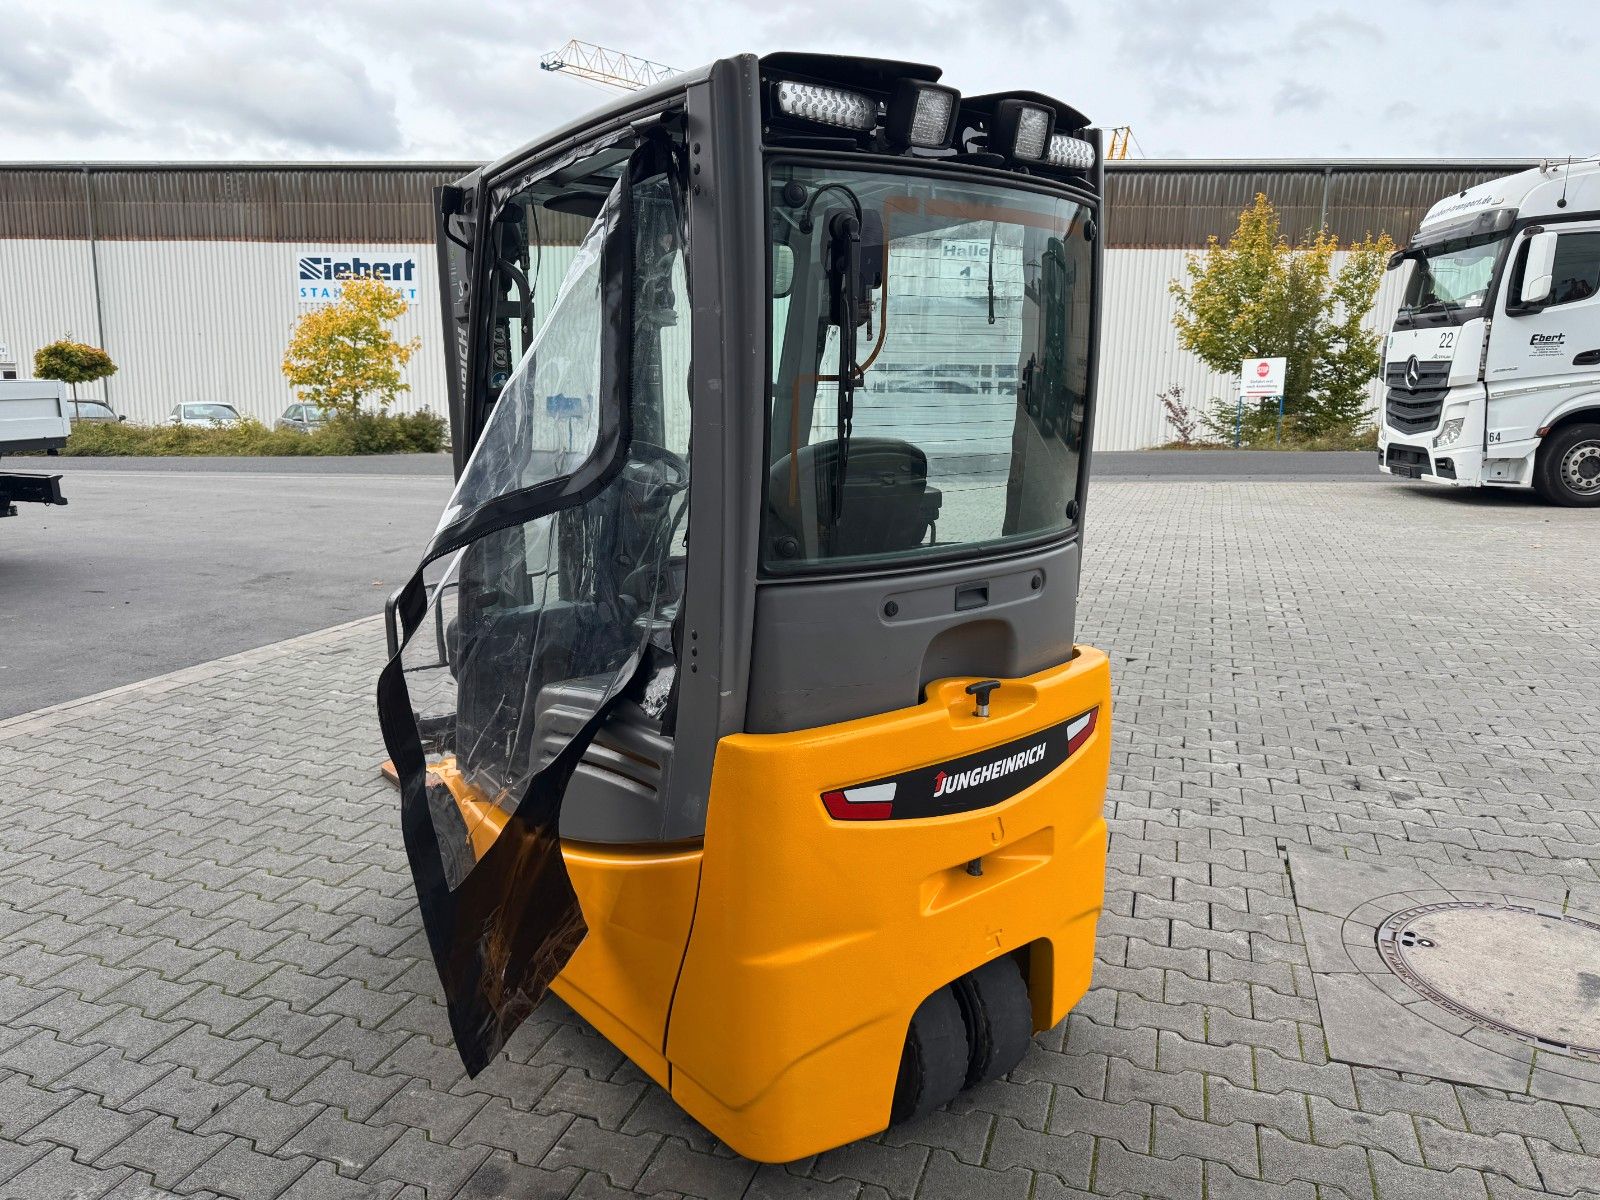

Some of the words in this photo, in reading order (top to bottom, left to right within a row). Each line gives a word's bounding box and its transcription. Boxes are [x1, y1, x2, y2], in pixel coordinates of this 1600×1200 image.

[943, 244, 989, 257] Halle
[299, 257, 416, 281] Siebert
[960, 266, 971, 287] 1
[1439, 332, 1454, 348] 22
[1530, 332, 1566, 345] Ebert
[1489, 432, 1501, 442] 64
[933, 742, 1047, 798] JUNGHEINRICH
